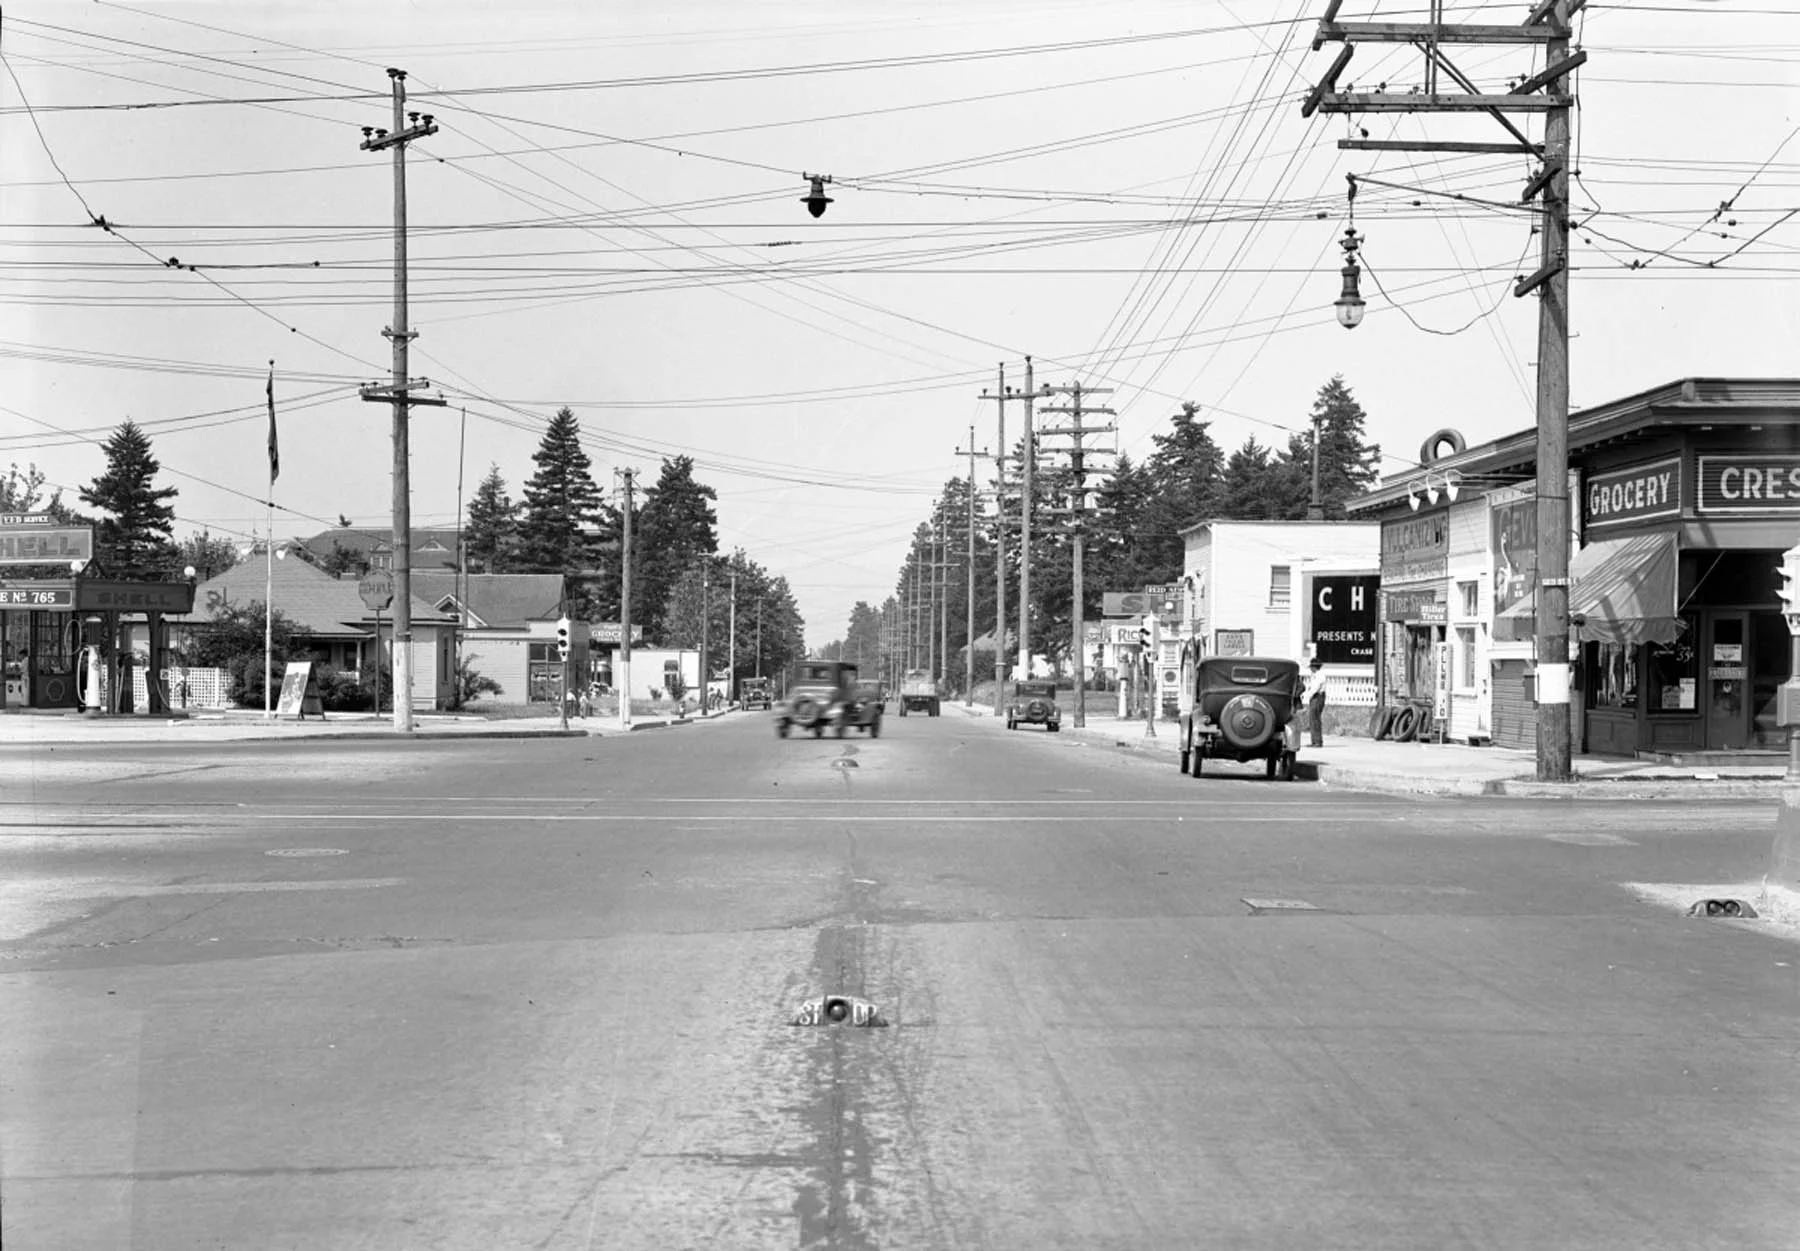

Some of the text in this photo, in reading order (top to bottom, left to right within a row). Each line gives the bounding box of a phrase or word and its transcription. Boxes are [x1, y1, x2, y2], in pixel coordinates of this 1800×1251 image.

[1720, 467, 1800, 499] CRES
[1590, 472, 1670, 515] GROCERY
[31, 592, 56, 603] 765
[97, 592, 172, 606] SHELL
[591, 630, 640, 638] GROCY
[1317, 631, 1364, 641] PRESENTS
